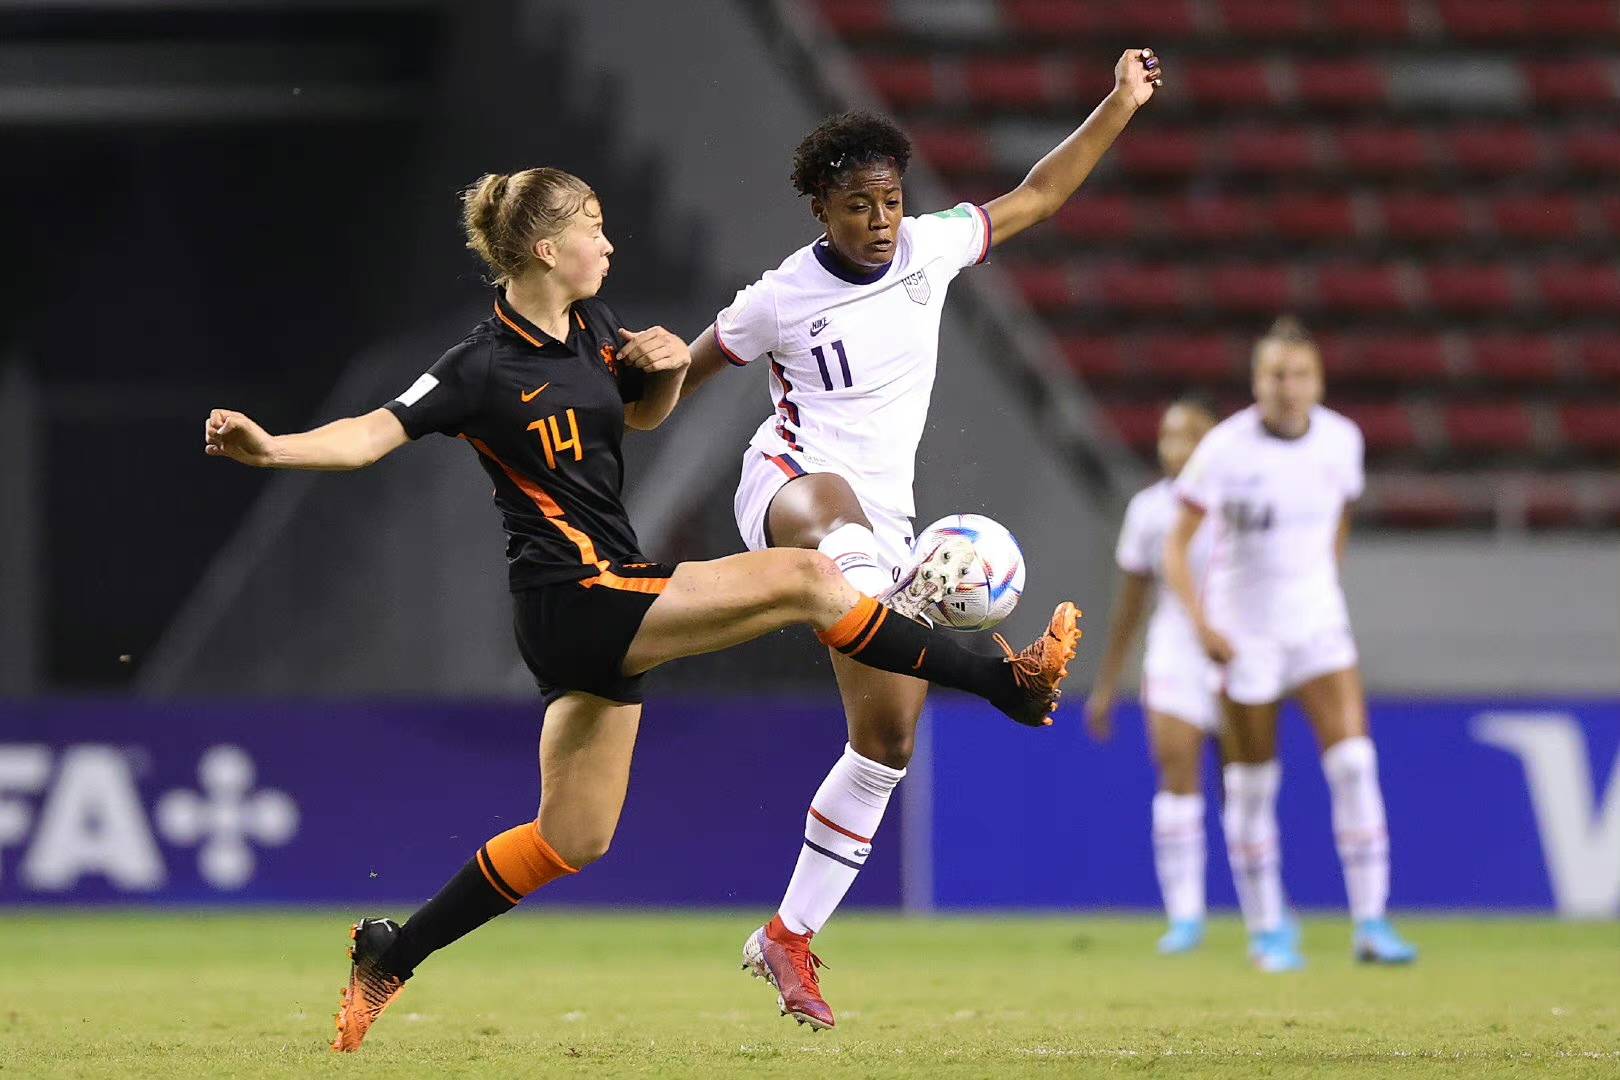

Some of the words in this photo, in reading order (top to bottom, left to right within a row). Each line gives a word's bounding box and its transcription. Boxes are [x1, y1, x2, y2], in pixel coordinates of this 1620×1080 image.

[903, 270, 923, 286] USA
[811, 340, 853, 391] 11
[526, 408, 582, 470] 14
